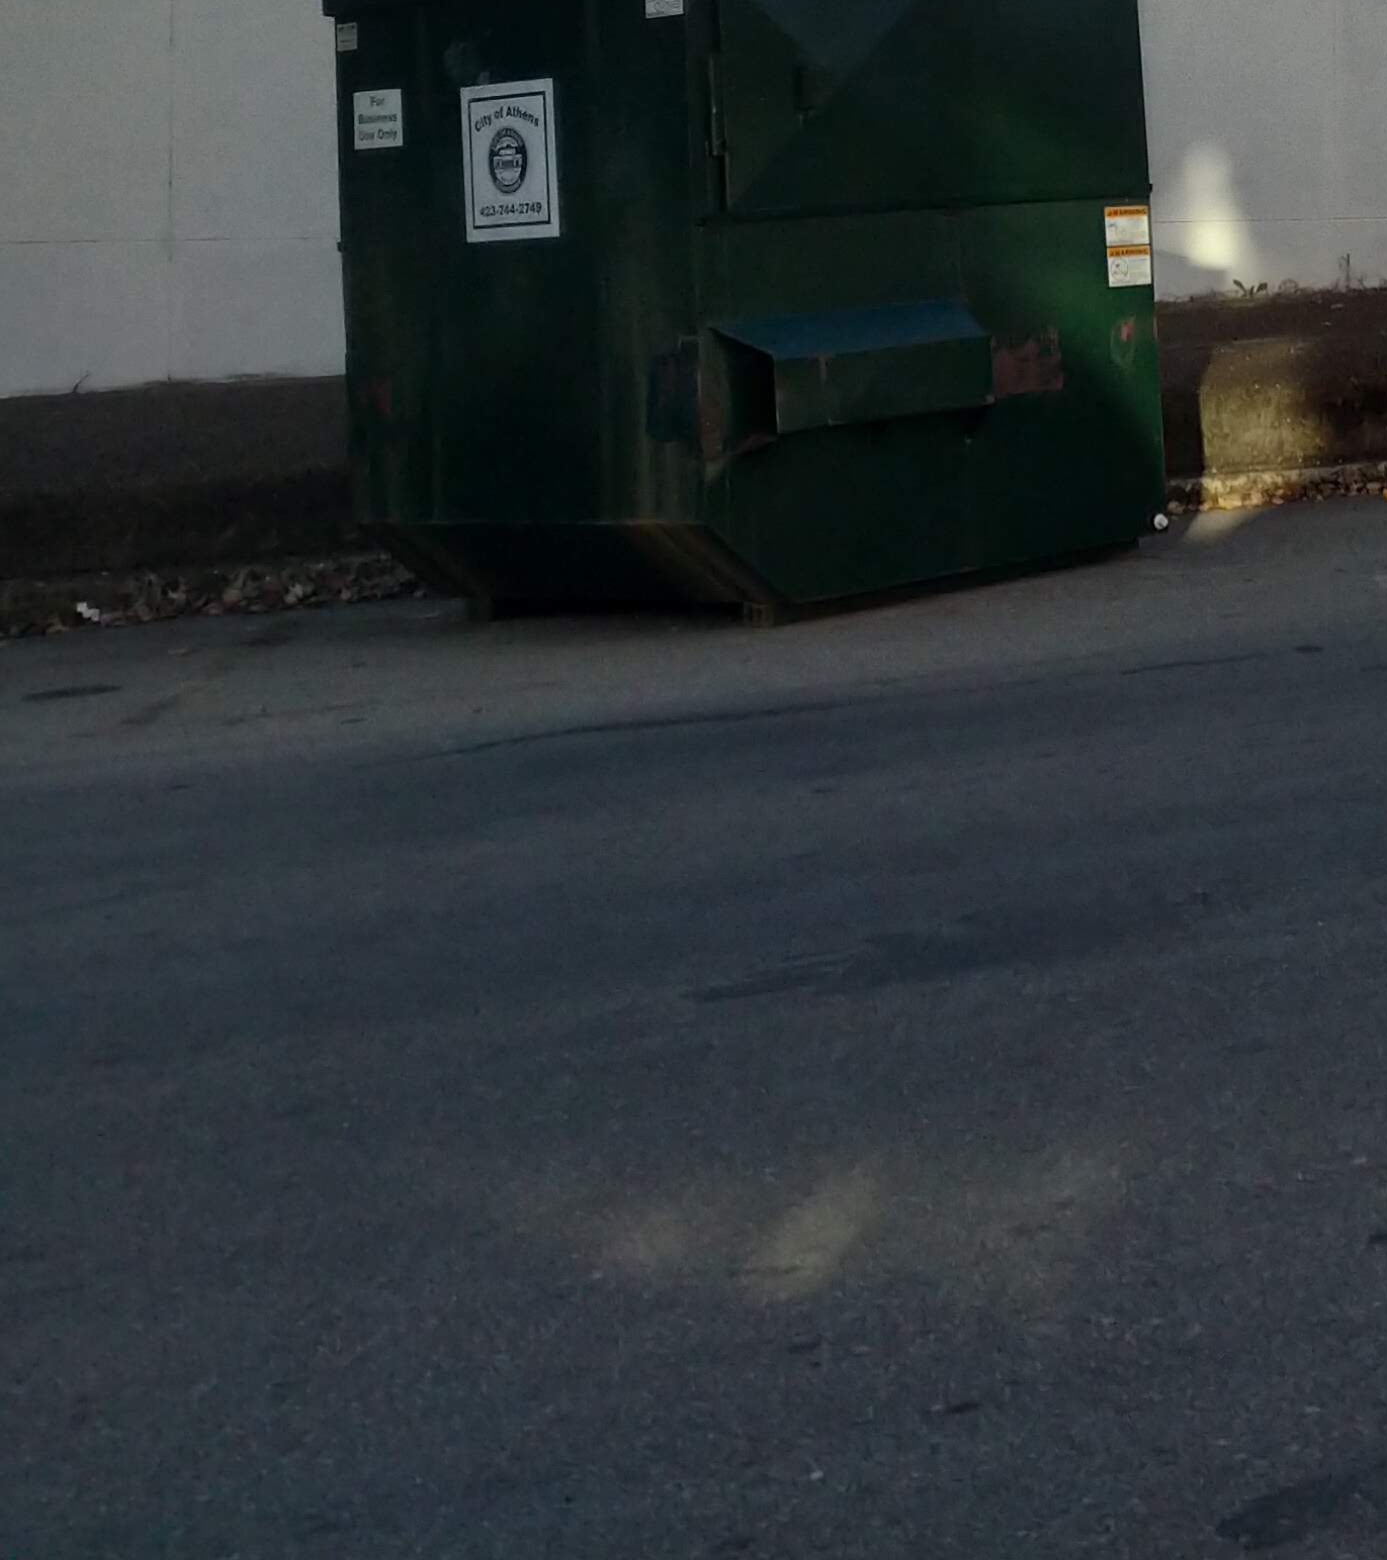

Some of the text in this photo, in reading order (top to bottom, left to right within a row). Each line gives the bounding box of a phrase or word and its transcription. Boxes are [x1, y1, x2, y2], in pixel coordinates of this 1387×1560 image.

[475, 105, 540, 132] City of Athens
